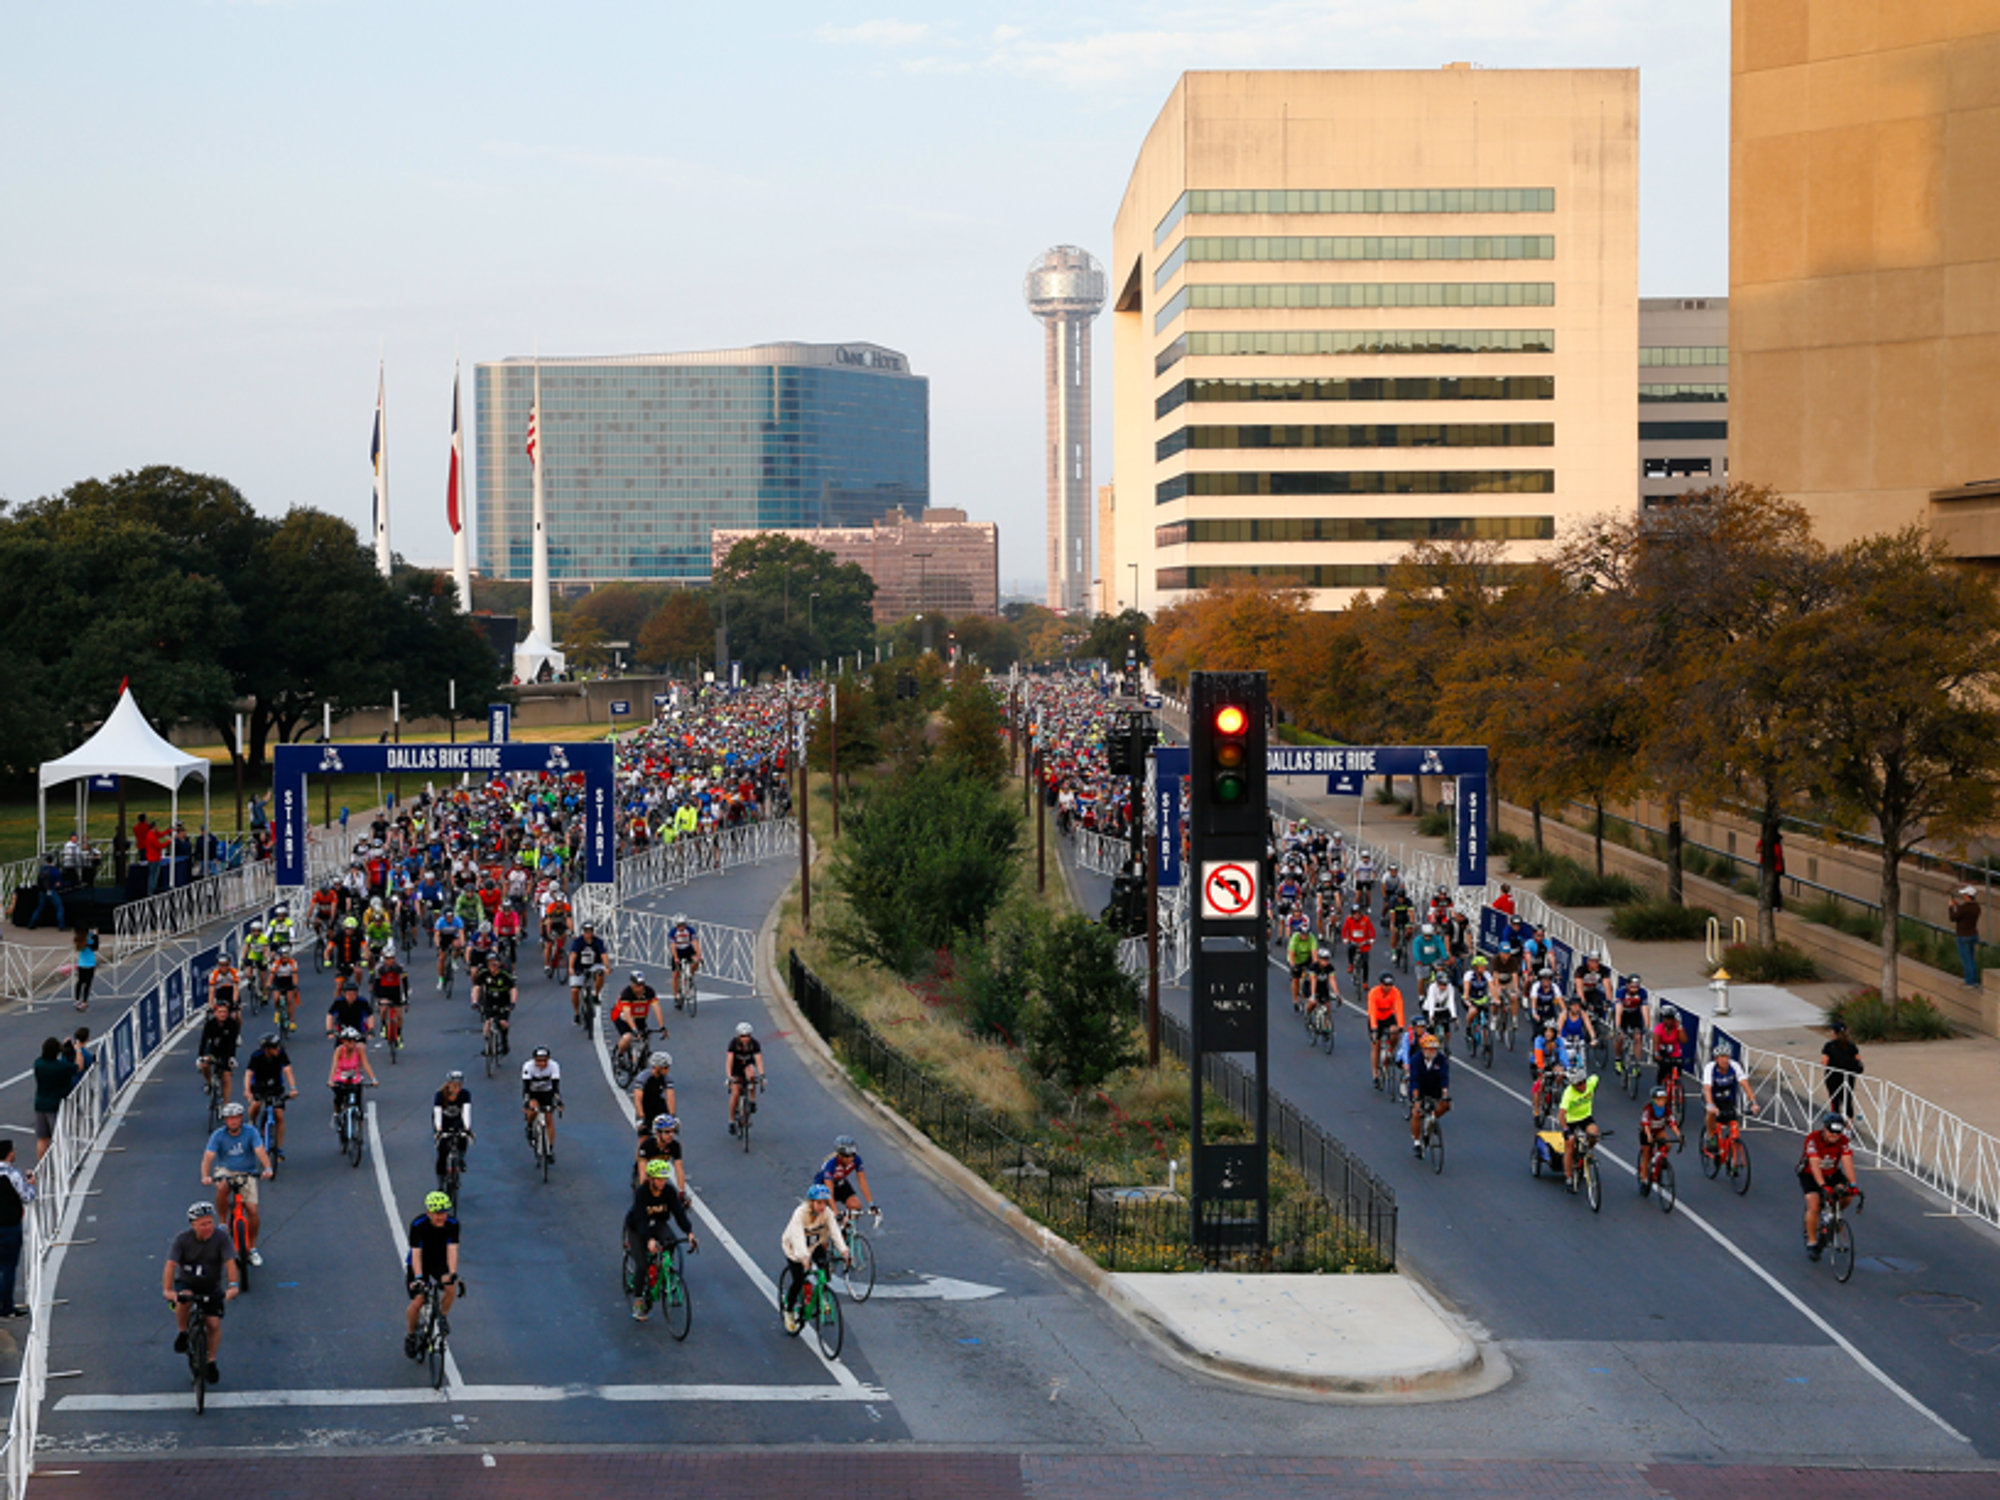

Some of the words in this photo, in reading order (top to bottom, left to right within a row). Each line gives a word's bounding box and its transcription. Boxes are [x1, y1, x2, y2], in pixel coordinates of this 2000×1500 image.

[387, 748, 437, 768] DALLAS
[439, 748, 469, 768] BIKE
[470, 748, 501, 768] RIDE
[1314, 751, 1344, 771] BIKE
[1345, 751, 1376, 771] RIDE
[284, 789, 293, 869] START
[595, 787, 604, 867] START
[1161, 792, 1170, 871] START
[1468, 792, 1477, 871] START
